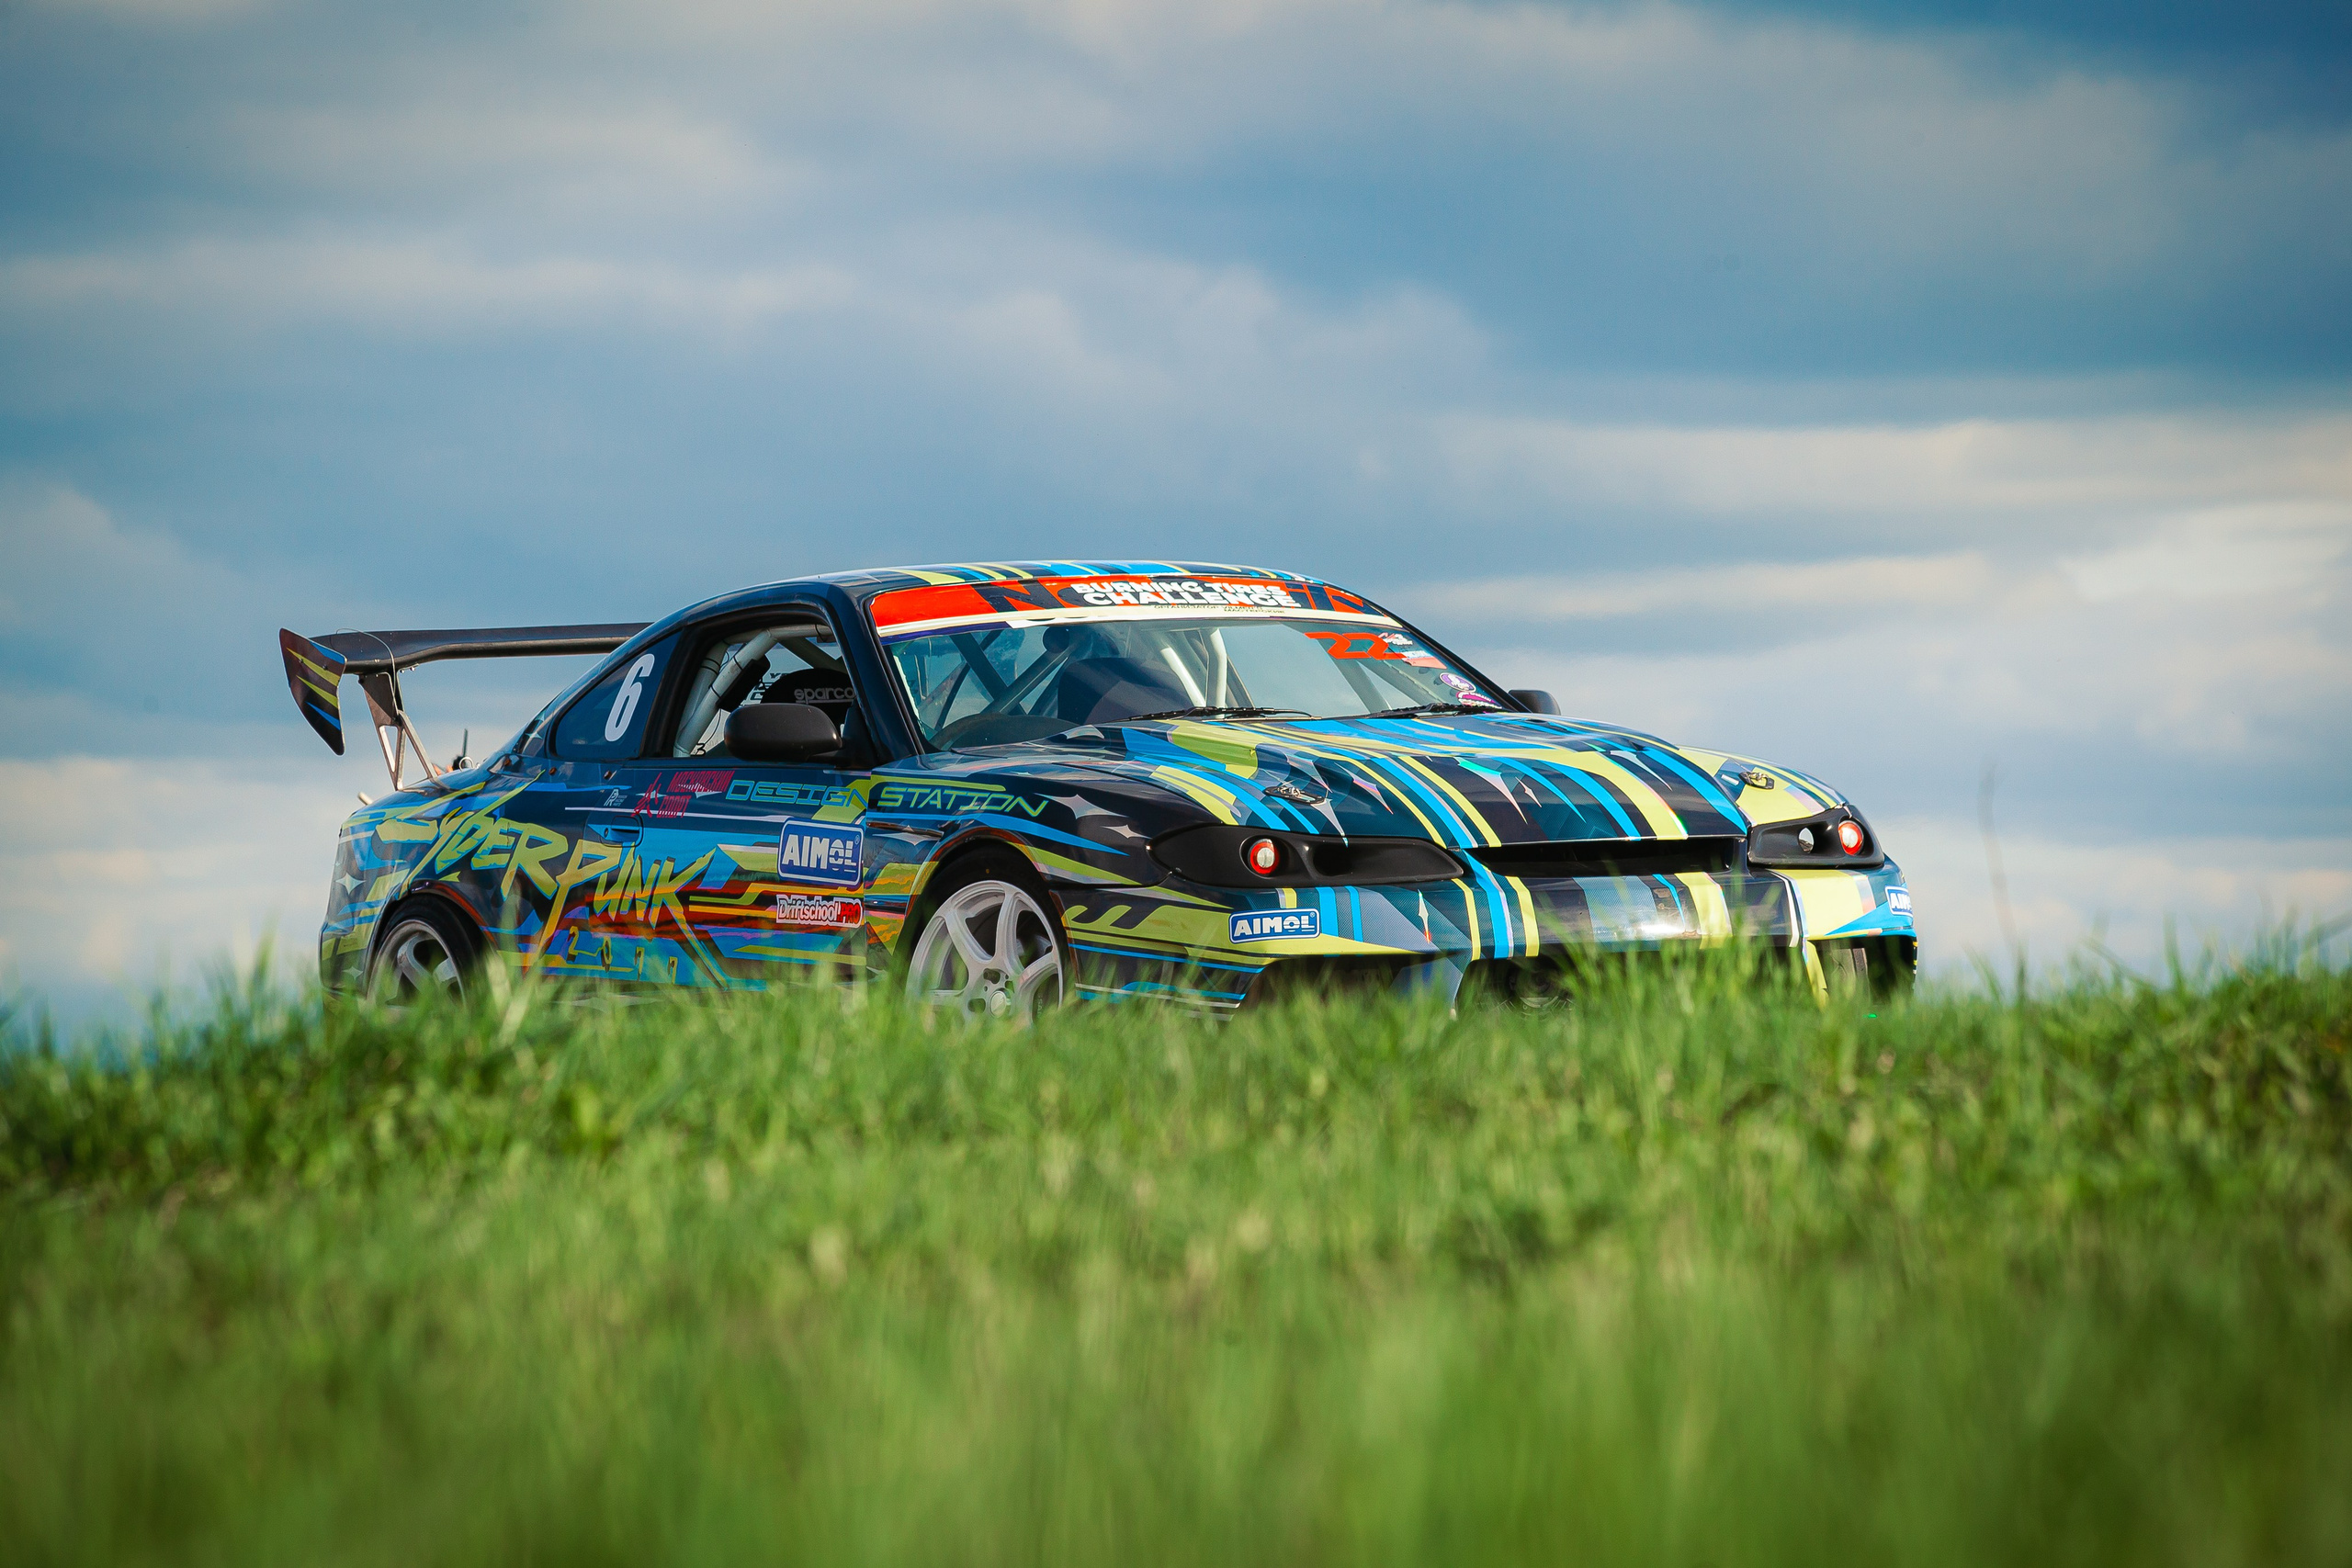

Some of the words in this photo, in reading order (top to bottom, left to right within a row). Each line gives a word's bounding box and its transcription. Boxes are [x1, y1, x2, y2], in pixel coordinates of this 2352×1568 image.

[1070, 581, 1203, 597] BURNING
[1205, 581, 1287, 597] TIRES
[1083, 592, 1302, 607] CHALLENGE
[1305, 631, 1407, 660] 22
[605, 653, 655, 742] 6
[794, 687, 856, 705] sparco
[726, 780, 868, 807] DESIGN
[877, 786, 1049, 817] STATION
